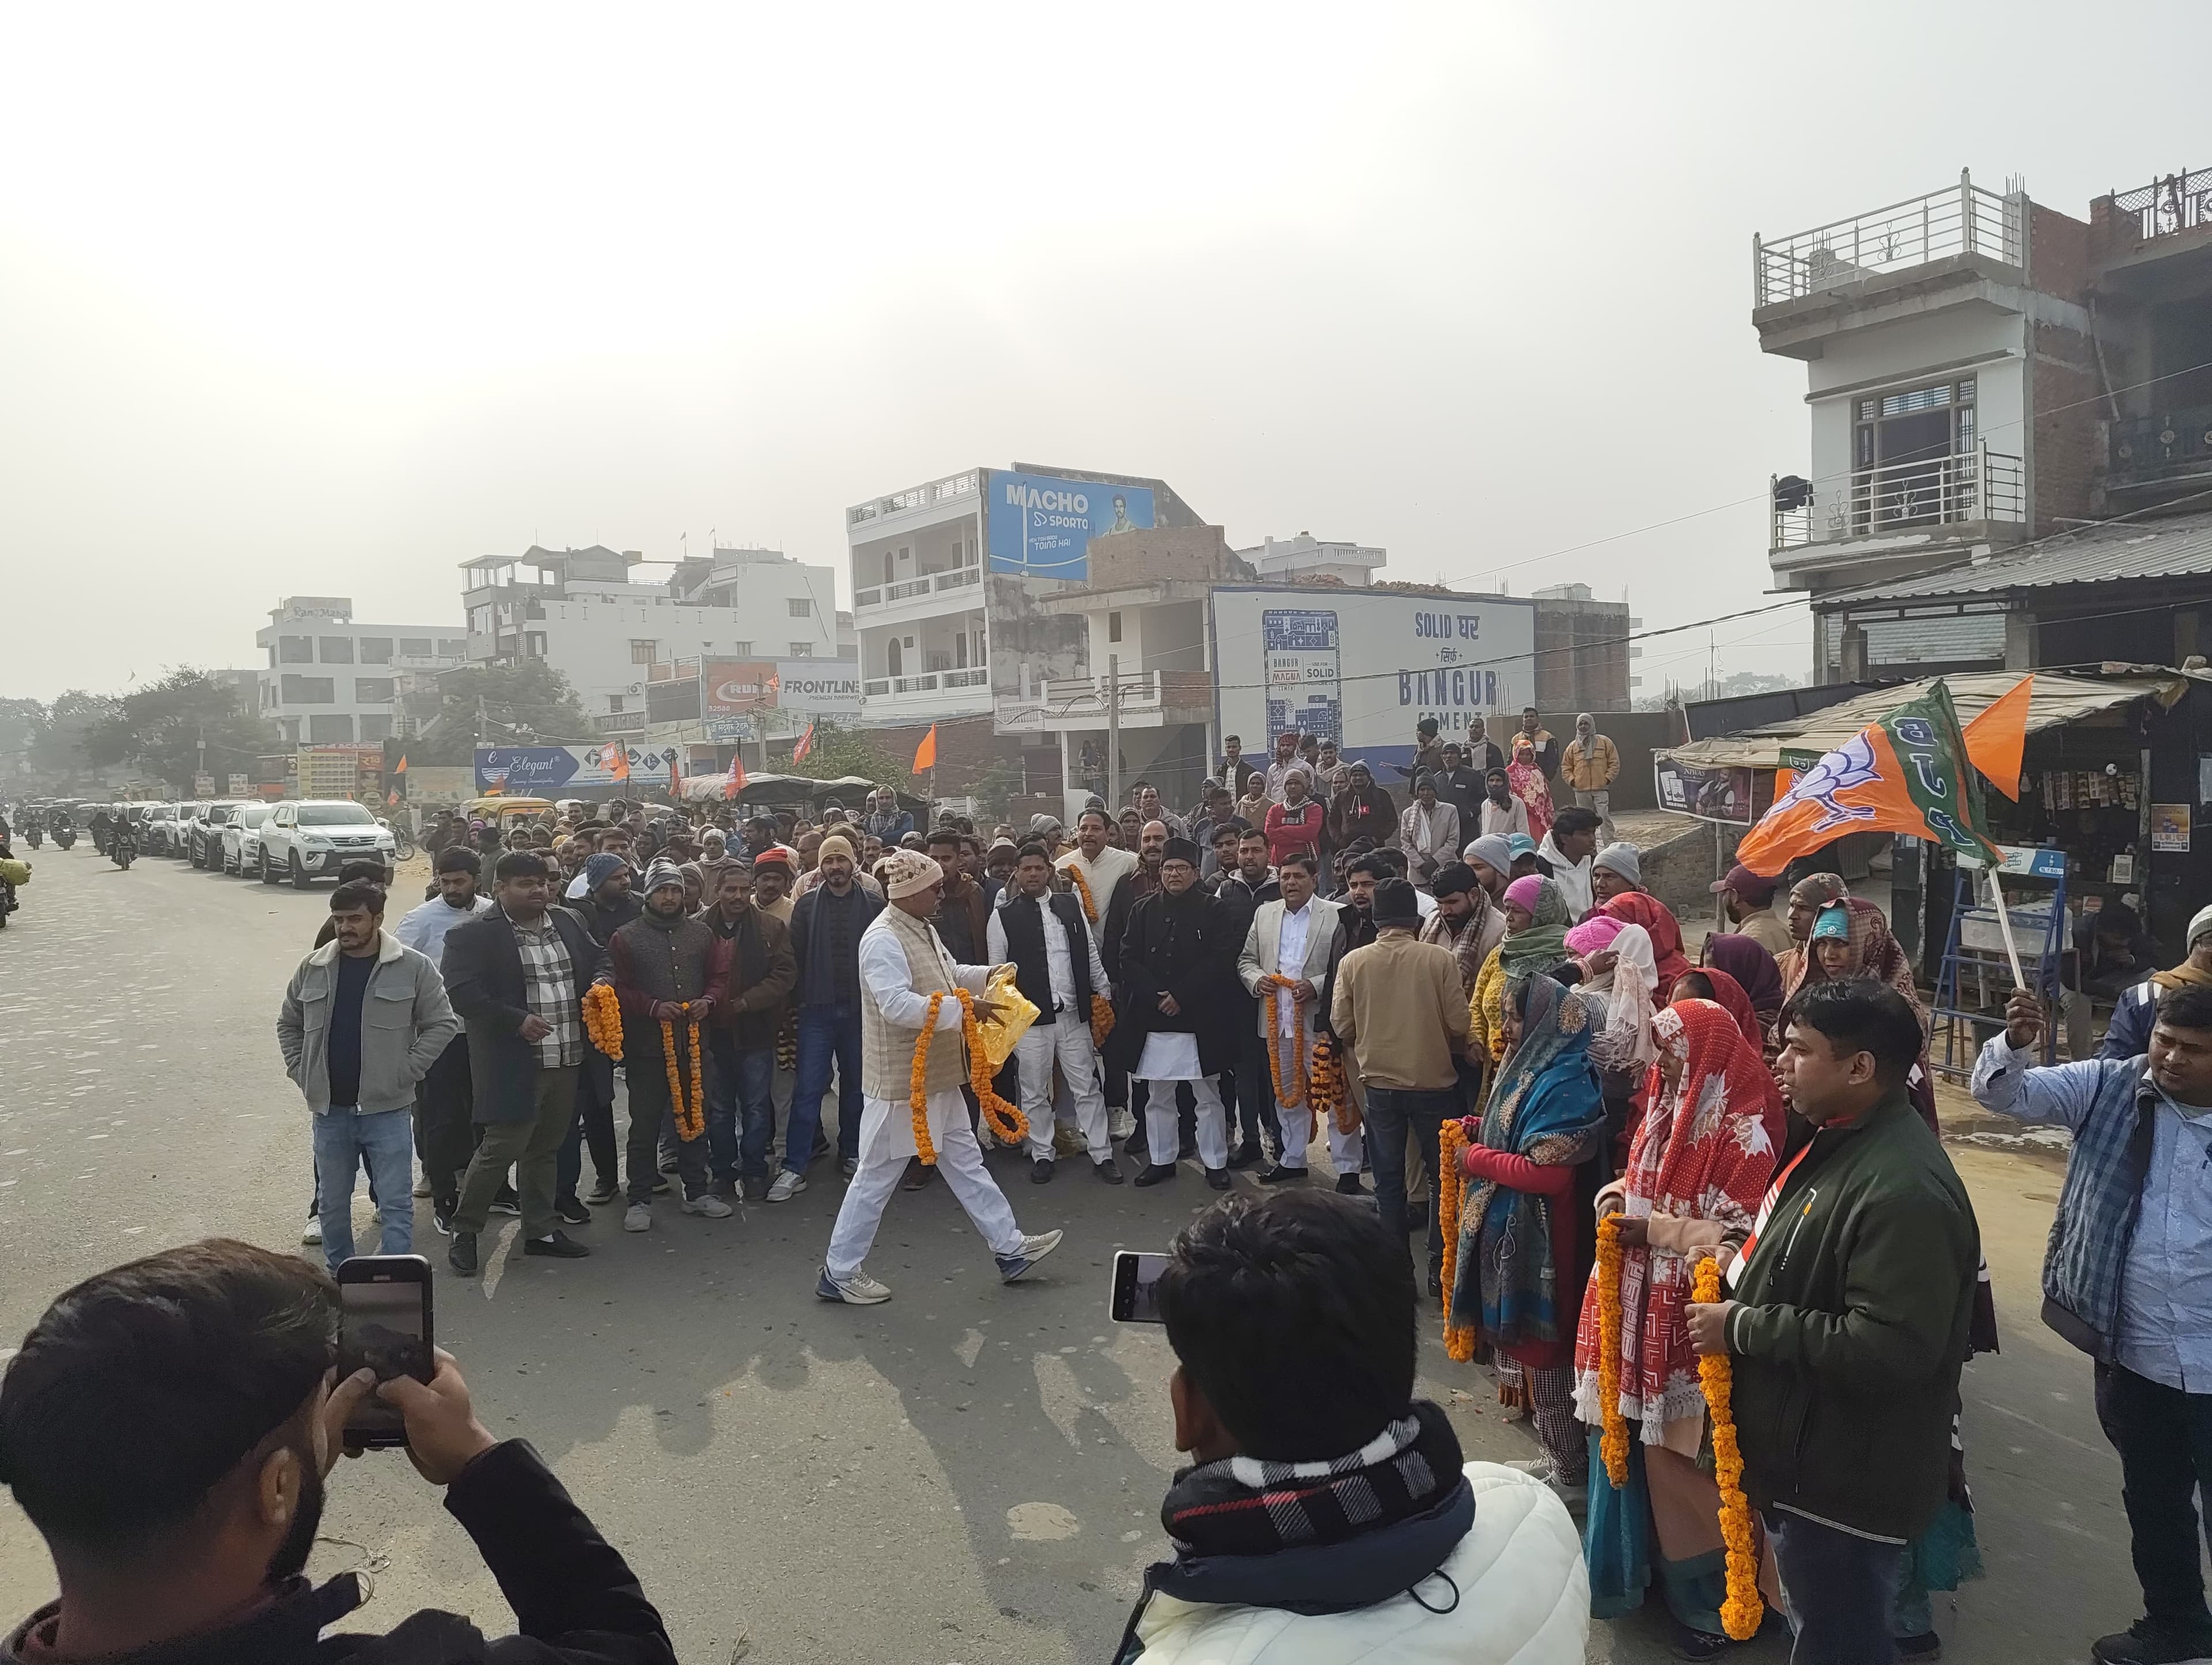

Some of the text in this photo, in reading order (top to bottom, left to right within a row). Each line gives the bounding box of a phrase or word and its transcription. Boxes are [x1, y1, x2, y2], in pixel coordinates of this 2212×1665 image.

[1006, 484, 1089, 514] MACHO
[1049, 515, 1088, 529] SPORTO
[1058, 538, 1071, 548] HAI
[1415, 612, 1480, 640] SOLID घर
[1273, 658, 1298, 667] BANGUR
[1272, 672, 1301, 683] MAGNA
[1306, 668, 1334, 678] SOLID
[1398, 669, 1497, 706] BANGUR
[510, 756, 554, 777] Elegant
